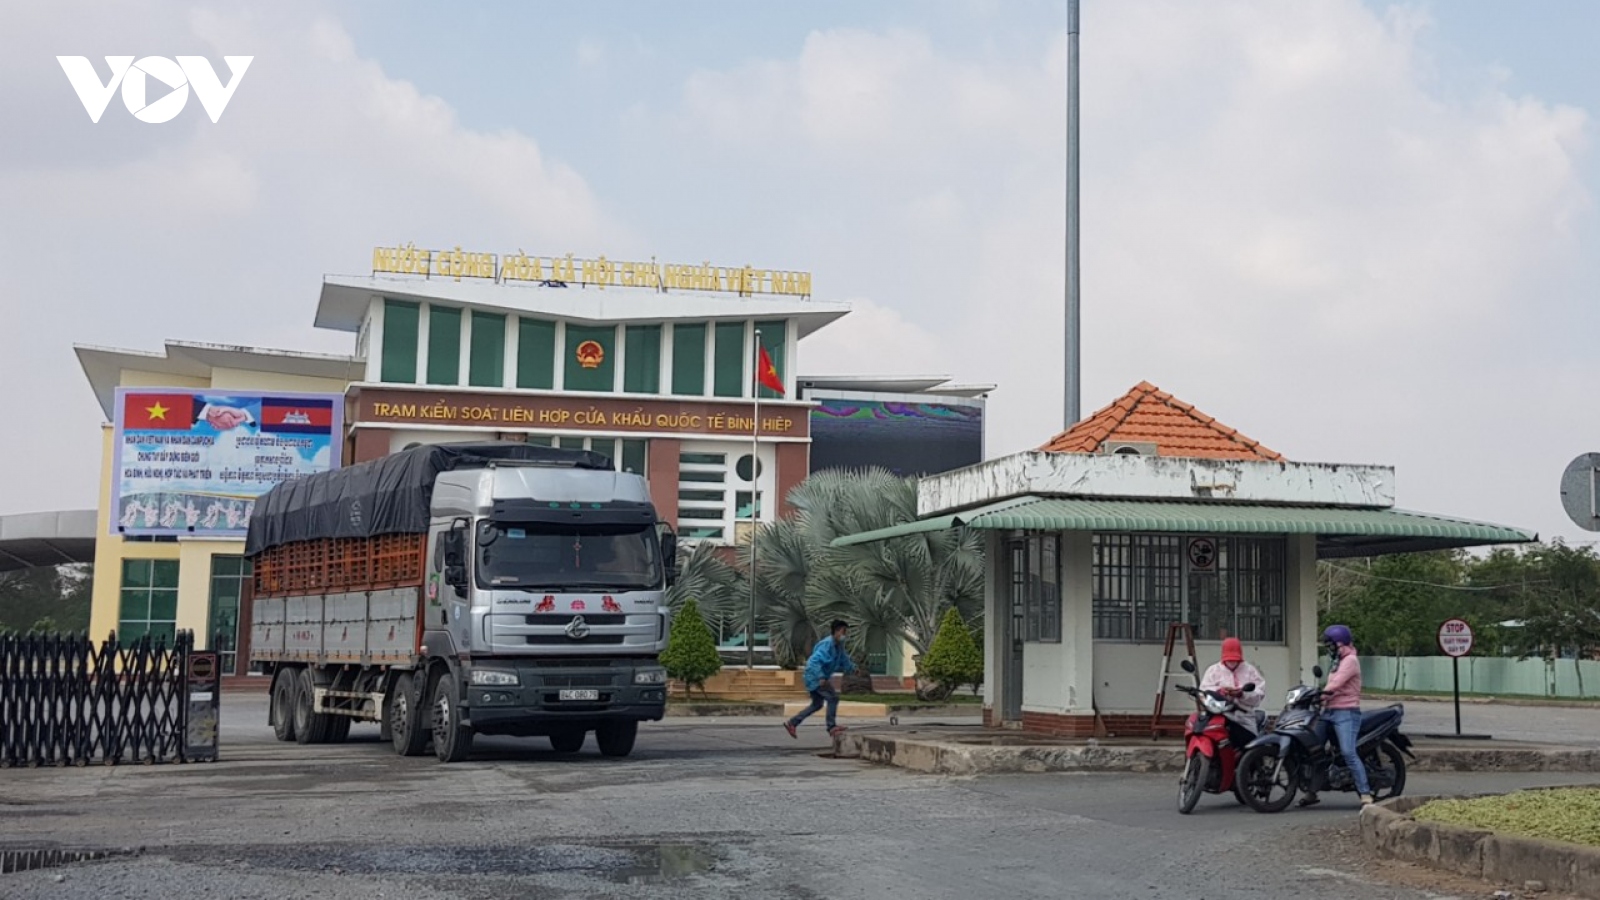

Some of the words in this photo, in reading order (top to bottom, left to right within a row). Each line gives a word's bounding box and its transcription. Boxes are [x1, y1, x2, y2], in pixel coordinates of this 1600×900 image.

[374, 243, 430, 273] NƯỚC
[437, 246, 493, 282] CỘNG
[502, 249, 543, 280] HÒA
[551, 253, 575, 282] XÃ
[582, 256, 615, 290] HỘI
[620, 257, 660, 287] CHỦ
[664, 260, 720, 292] NGHĨA
[725, 265, 765, 297] VIỆT
[771, 271, 811, 295] NAM
[374, 402, 416, 419] TRẠM
[420, 399, 457, 418] KIỂM
[461, 405, 499, 420] SOÁT
[503, 406, 534, 422] LIÊN
[539, 409, 570, 426] HỢP
[574, 406, 606, 425] CỬA
[612, 407, 651, 426] KHẨU
[656, 411, 700, 428] QUỐC
[707, 411, 726, 429] TẾ
[1446, 623, 1465, 633] STOP
